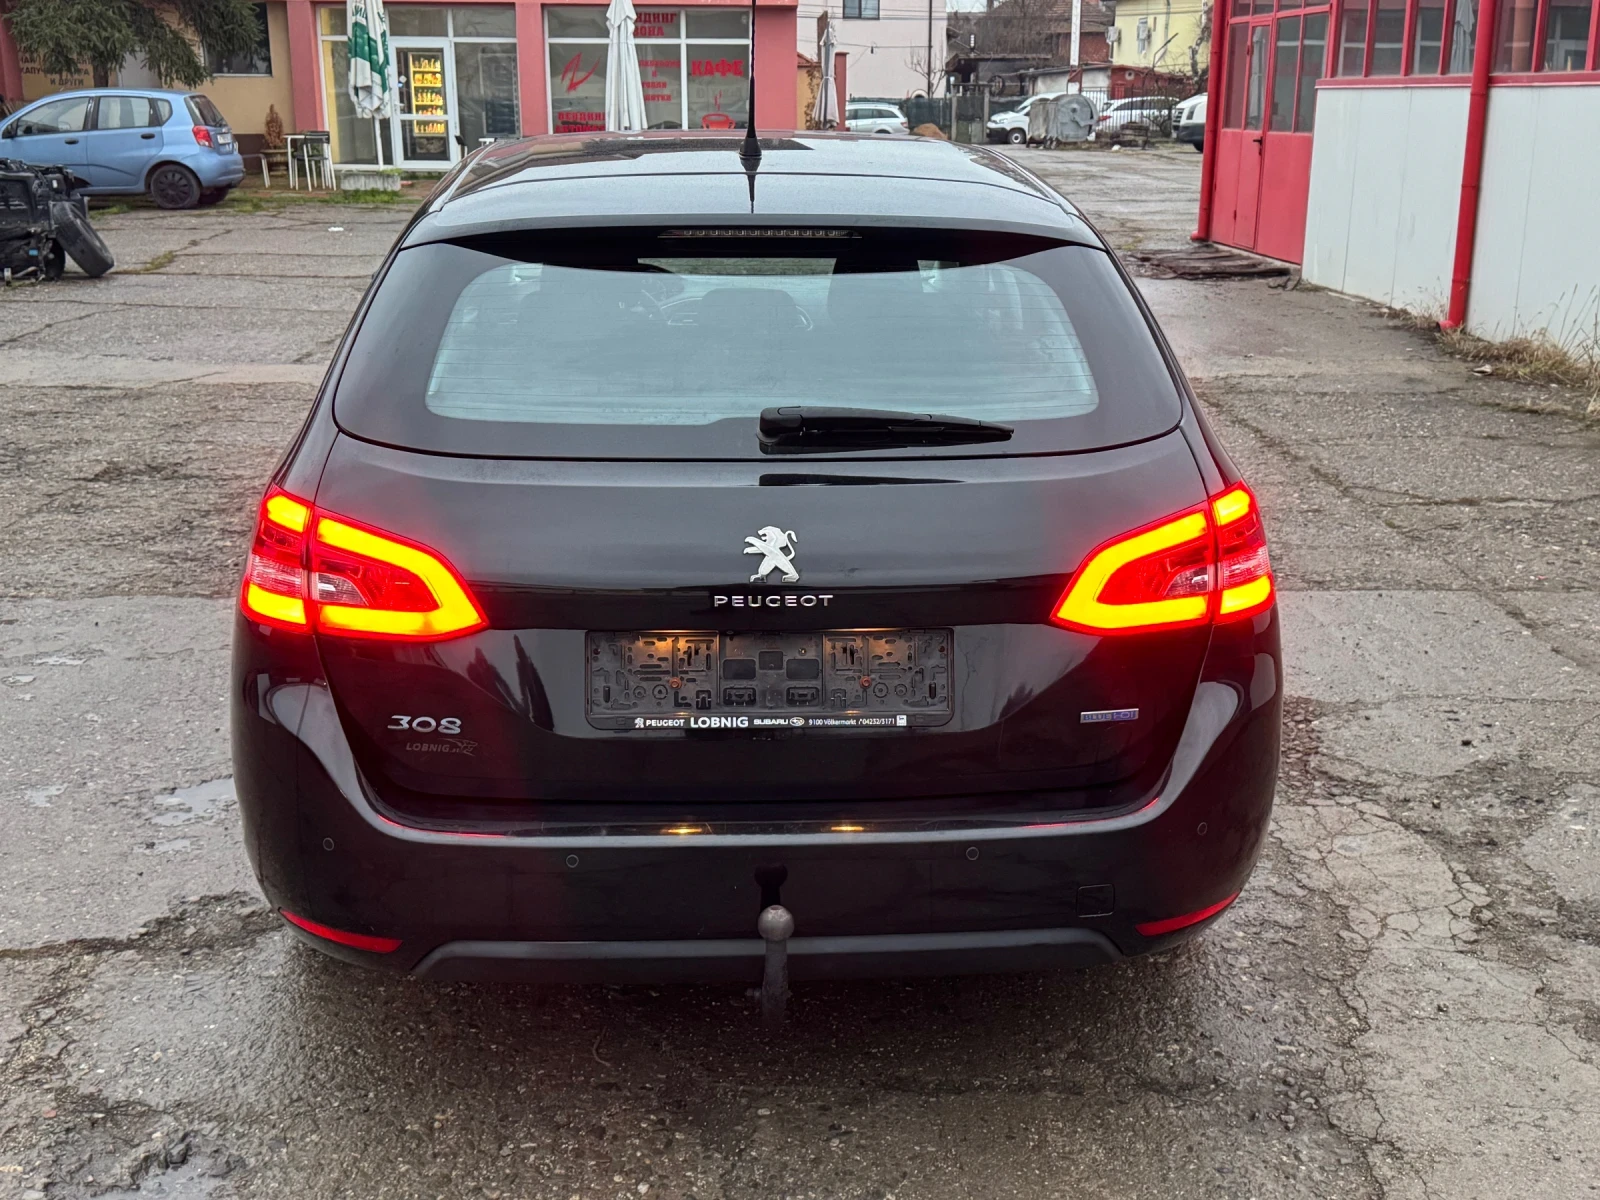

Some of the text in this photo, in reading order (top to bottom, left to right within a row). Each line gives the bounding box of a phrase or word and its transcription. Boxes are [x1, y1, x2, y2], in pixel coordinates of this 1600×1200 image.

[636, 12, 677, 24] НДИНГ
[691, 59, 744, 77] КАФЕ
[714, 595, 834, 607] PEUGEOT
[387, 715, 461, 734] 308
[646, 719, 686, 727] PEUGEOT
[690, 716, 749, 728] LOBNIG
[406, 742, 460, 753] LOBNIG.at
